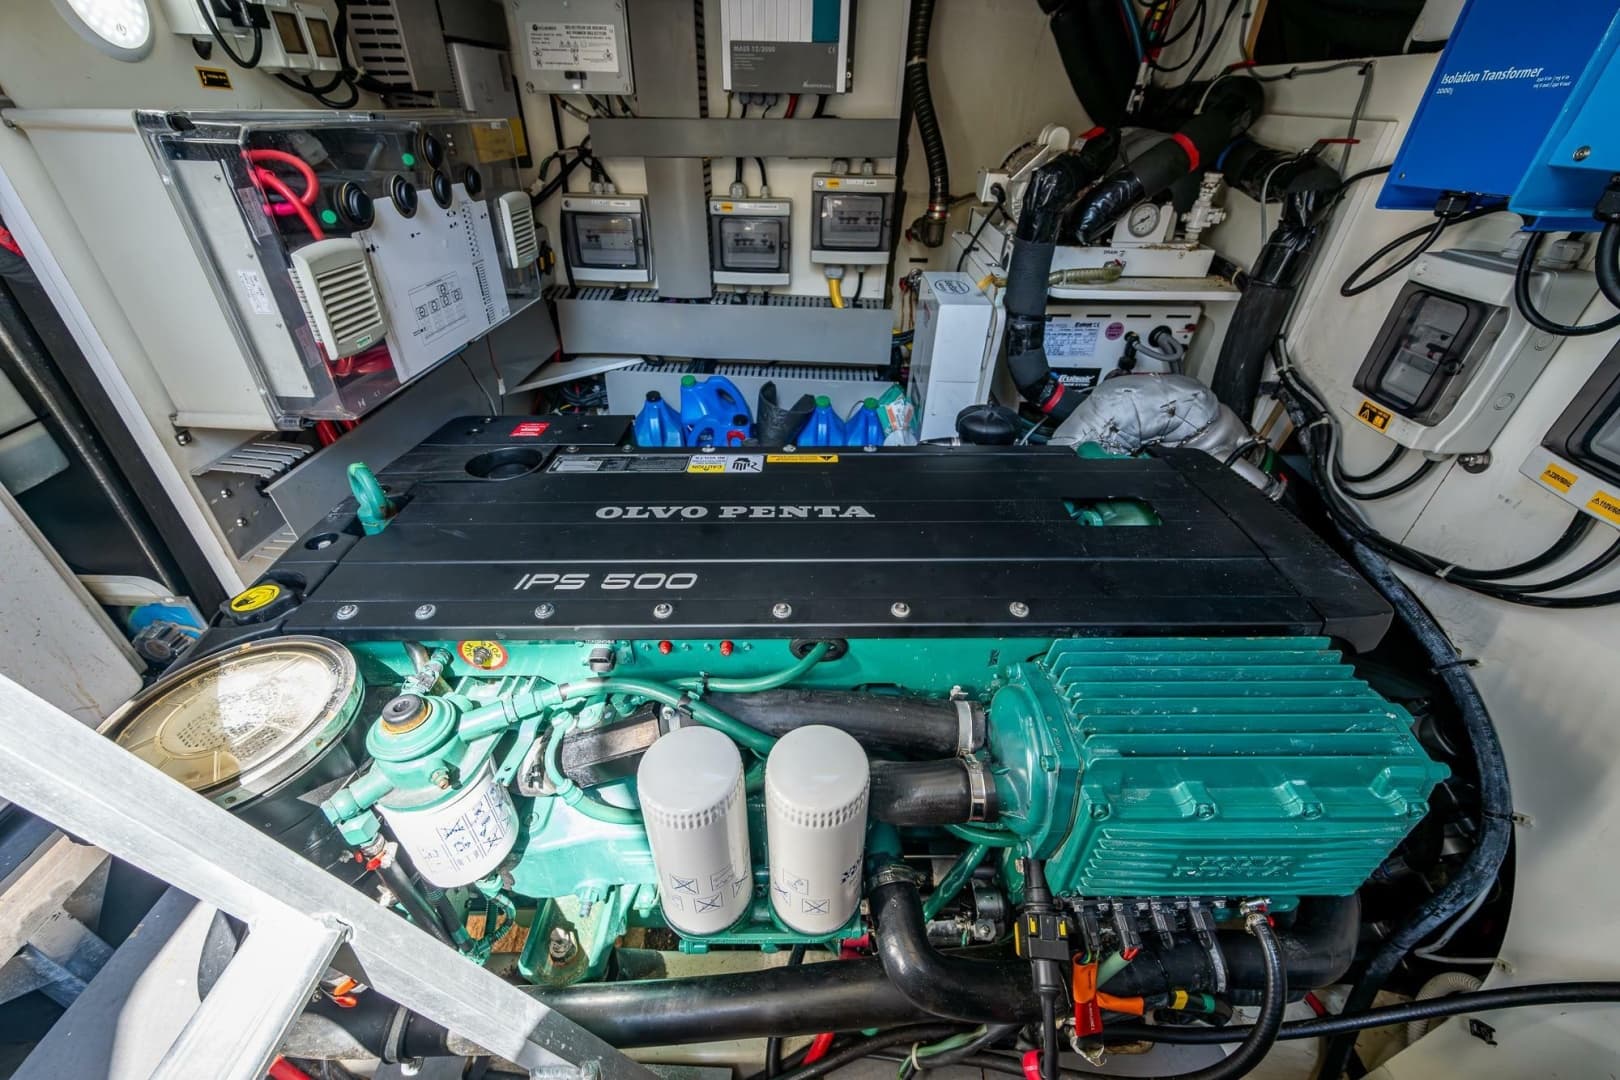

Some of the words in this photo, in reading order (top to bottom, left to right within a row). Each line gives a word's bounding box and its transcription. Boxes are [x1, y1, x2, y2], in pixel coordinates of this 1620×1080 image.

[1441, 71, 1481, 85] Isolation
[1481, 66, 1544, 81] Transformer
[595, 505, 709, 519] OLVO
[718, 505, 875, 519] PENTA
[513, 573, 590, 591] IPS
[600, 573, 699, 590] 500
